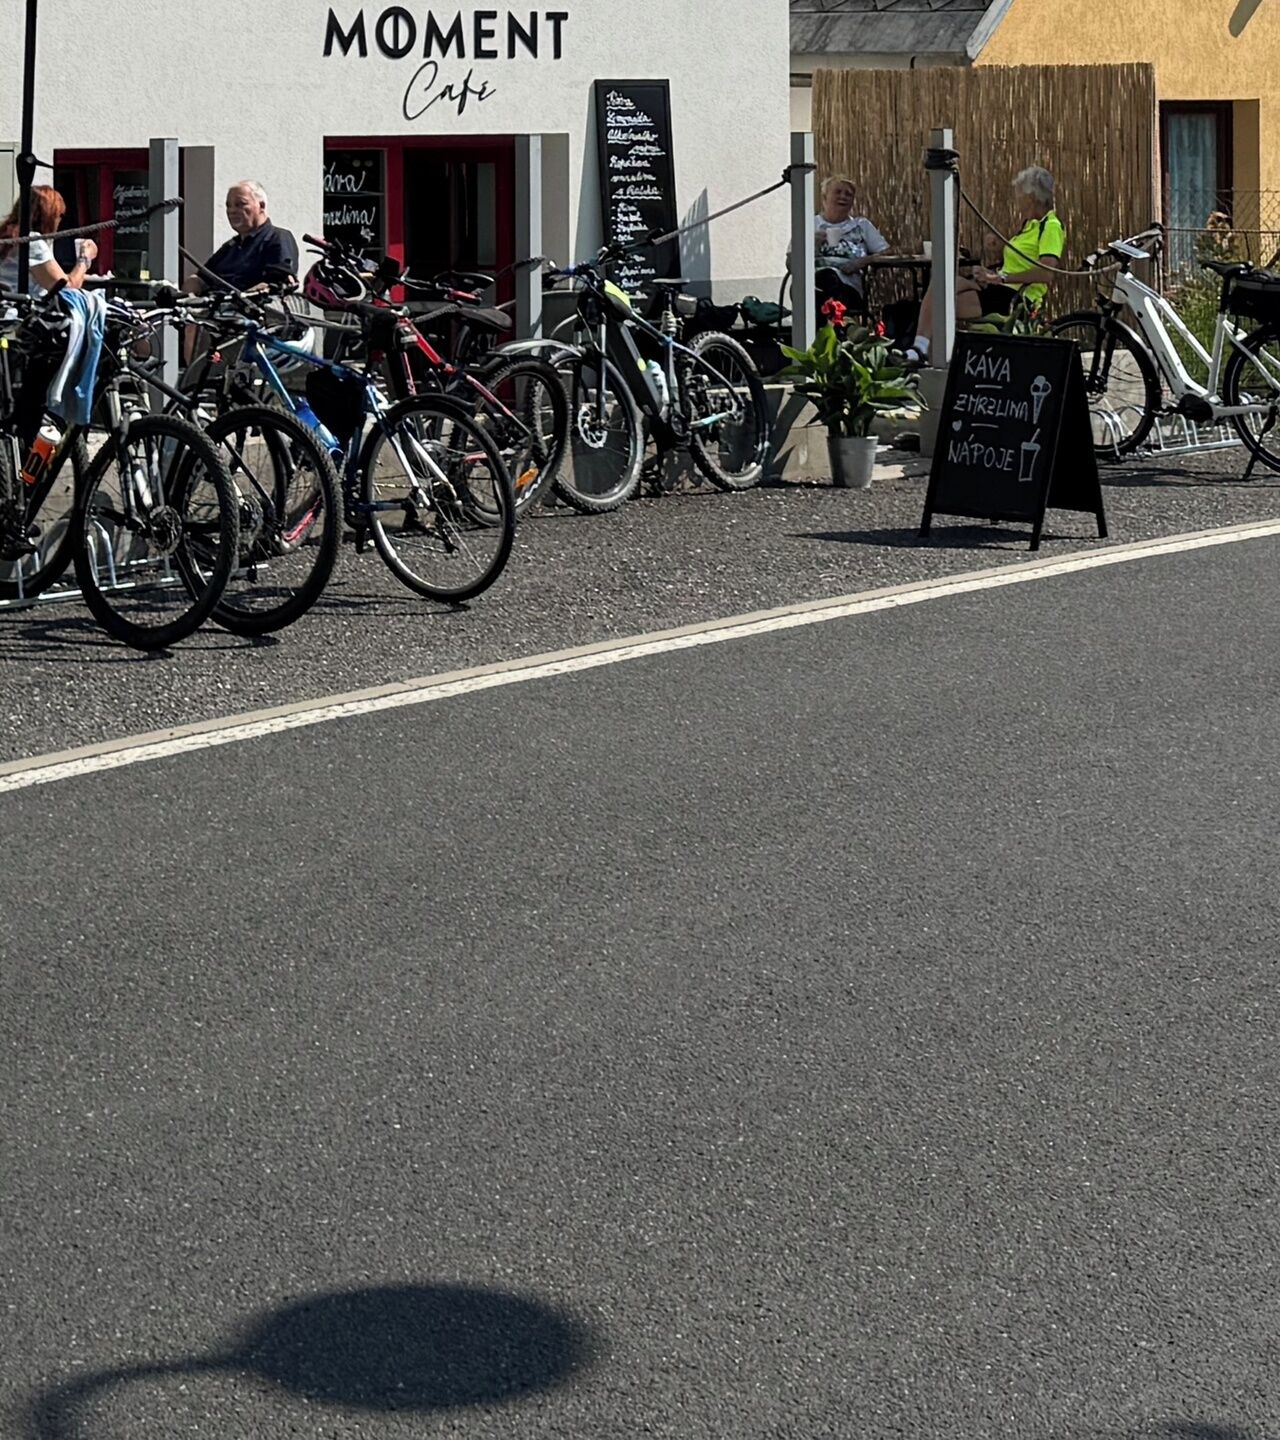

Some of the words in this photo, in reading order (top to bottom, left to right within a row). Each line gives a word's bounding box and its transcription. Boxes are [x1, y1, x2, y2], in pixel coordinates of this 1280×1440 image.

[322, 5, 569, 60] MOMENT
[323, 161, 366, 192] áva
[963, 346, 1012, 383] KÁVA
[953, 393, 1029, 423] ZMRZLINA
[947, 434, 1015, 471] NÁPOJE
